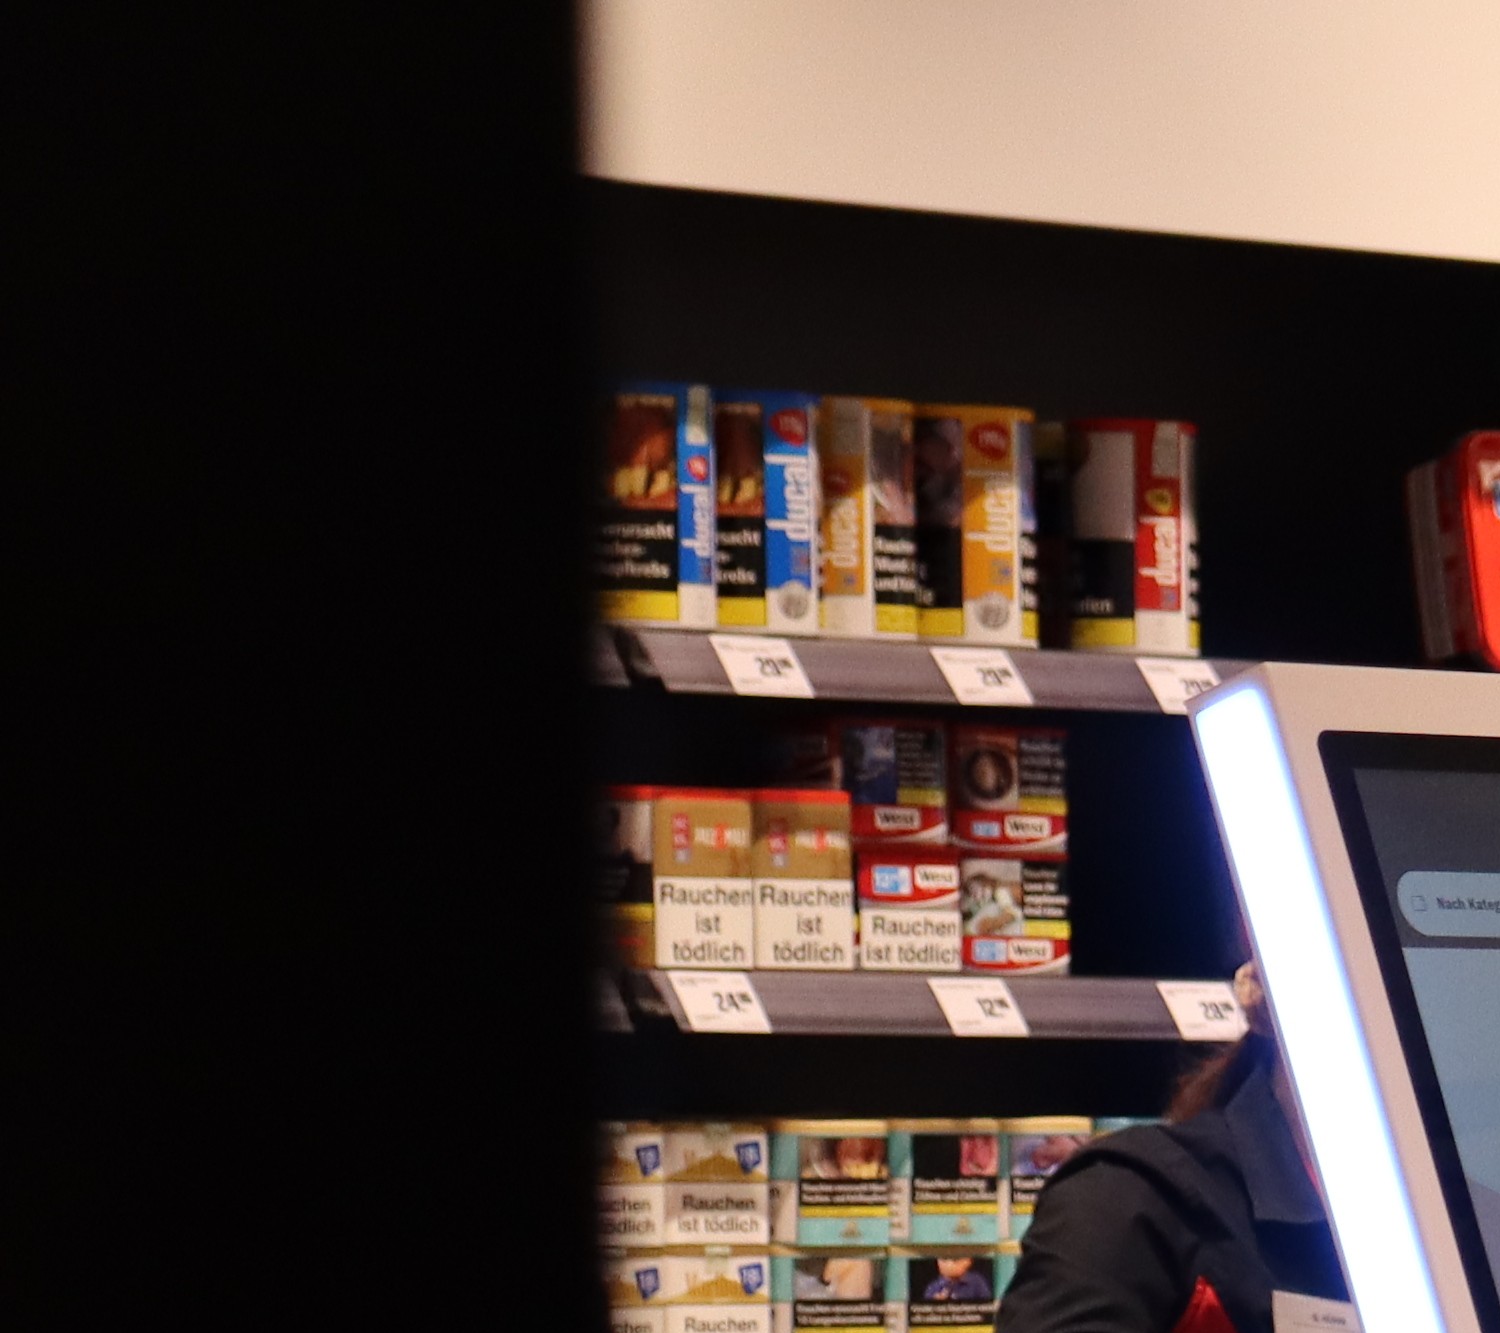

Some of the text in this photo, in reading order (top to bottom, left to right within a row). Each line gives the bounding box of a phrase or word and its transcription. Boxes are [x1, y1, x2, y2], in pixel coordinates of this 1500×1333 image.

[764, 454, 809, 542] ducal
[660, 886, 751, 905] Rauchen
[761, 886, 850, 906] Rauchen
[1436, 898, 1466, 911] Nach
[695, 914, 720, 934] ist
[797, 914, 821, 934] ist
[872, 916, 956, 936] Rauchen
[673, 941, 744, 963] tödlich
[774, 942, 844, 963] tödlich
[867, 943, 892, 962] ist
